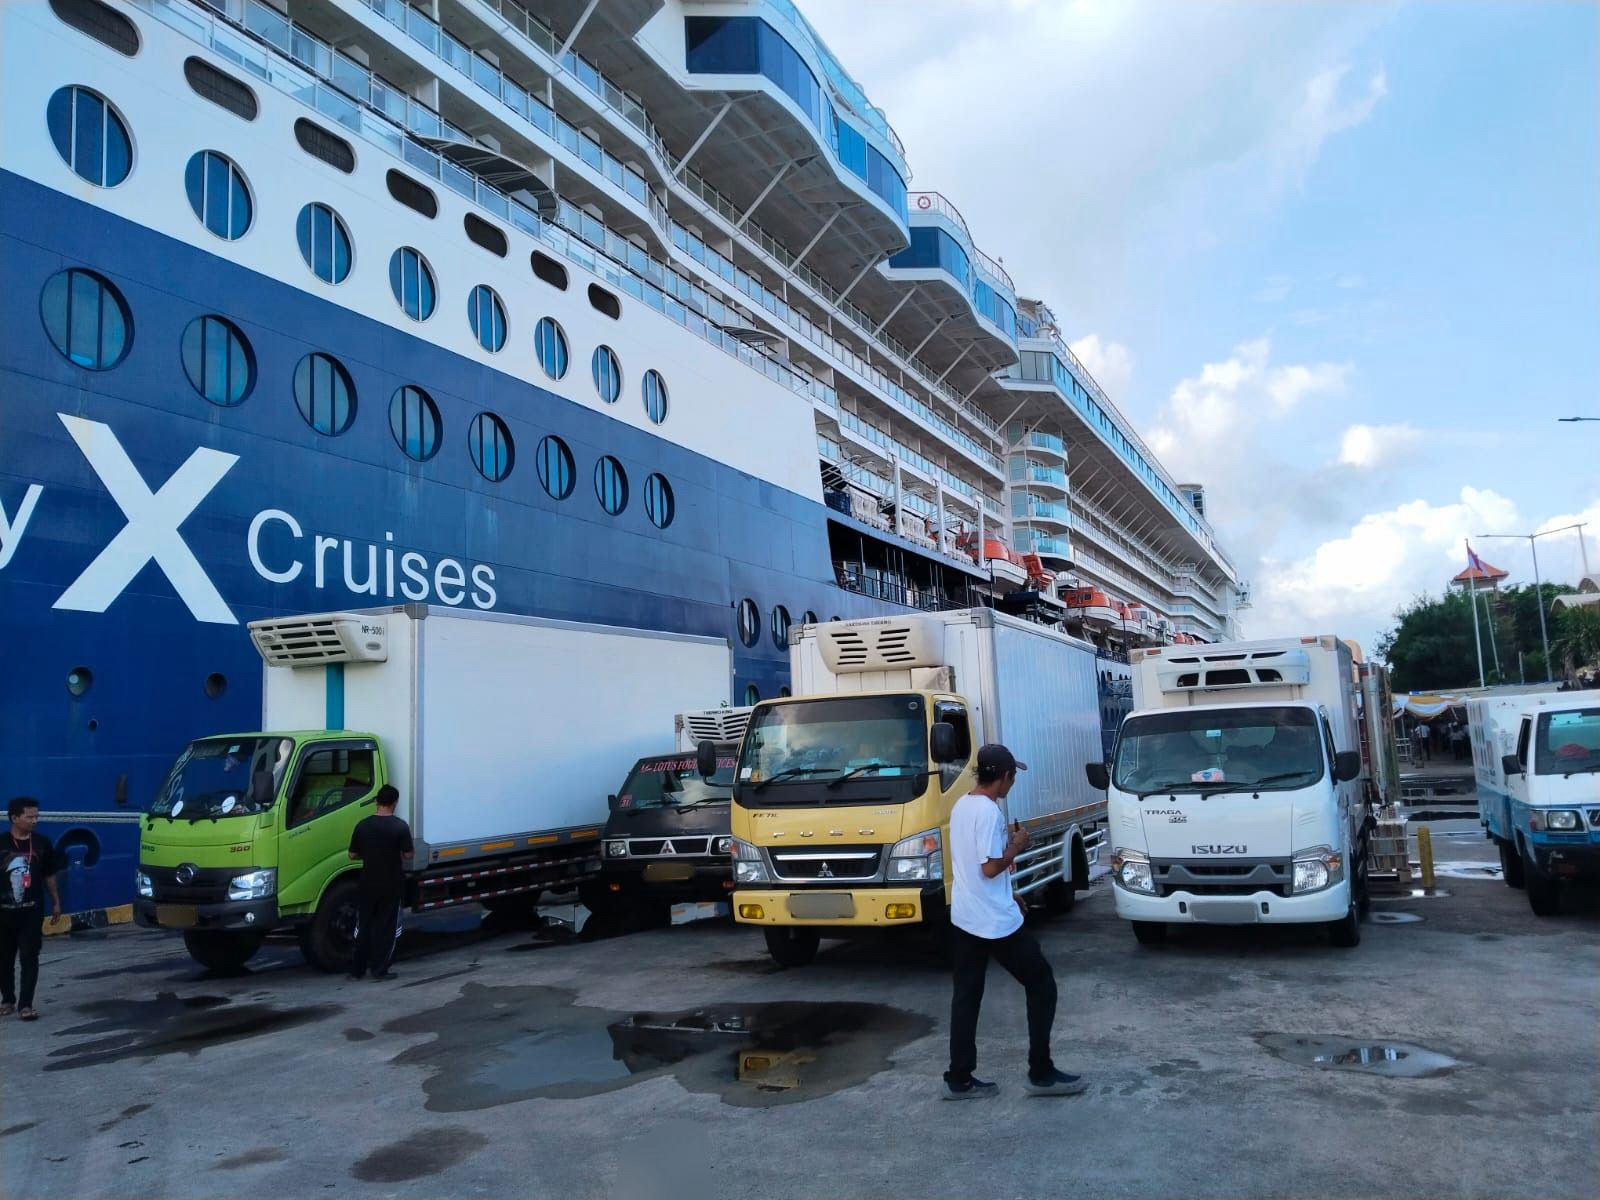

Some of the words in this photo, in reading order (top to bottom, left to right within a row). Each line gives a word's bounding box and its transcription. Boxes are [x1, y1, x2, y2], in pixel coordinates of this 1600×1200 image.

[247, 508, 498, 610] Cruises
[652, 759, 678, 772] LOTUS
[773, 828, 875, 838] FUSO
[1191, 845, 1248, 854] ISUZU
